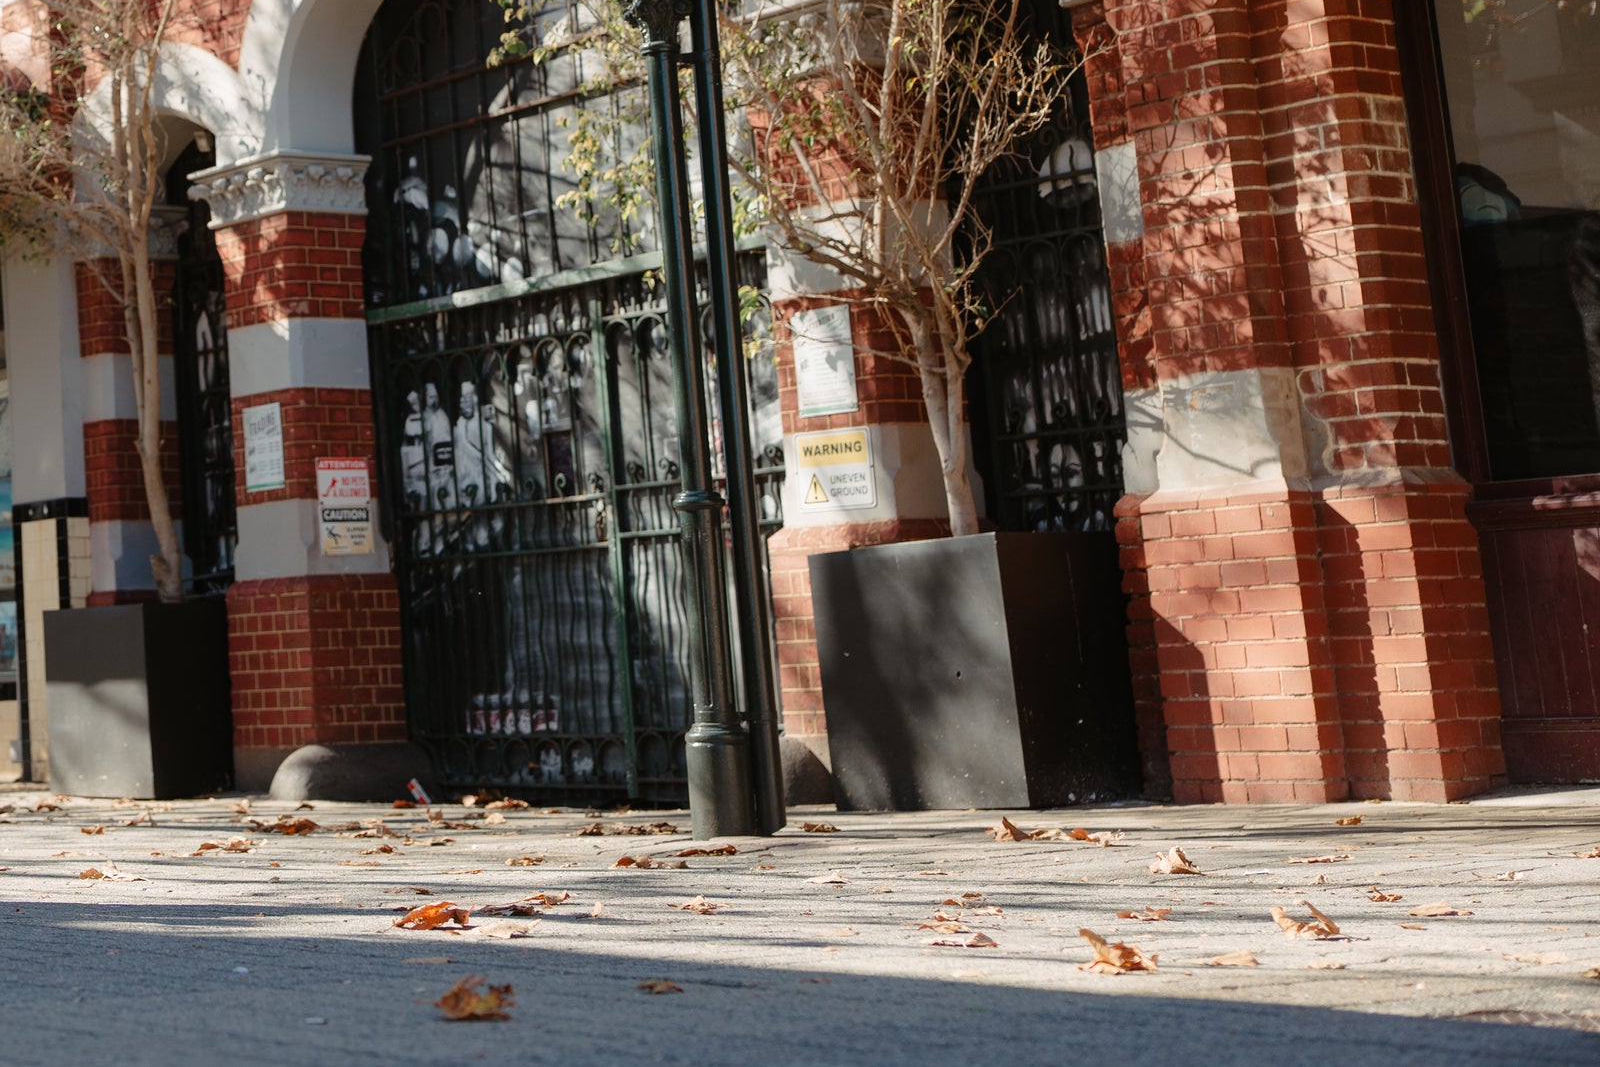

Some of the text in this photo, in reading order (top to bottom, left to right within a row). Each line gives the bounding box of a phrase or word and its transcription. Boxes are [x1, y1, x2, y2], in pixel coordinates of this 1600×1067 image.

[803, 441, 862, 457] WARNING
[318, 460, 367, 469] ATTENTION
[342, 477, 367, 486] NO PETS
[830, 473, 865, 484] UNEVEN
[830, 486, 868, 497] GROUND
[323, 508, 367, 520] CAUTION
